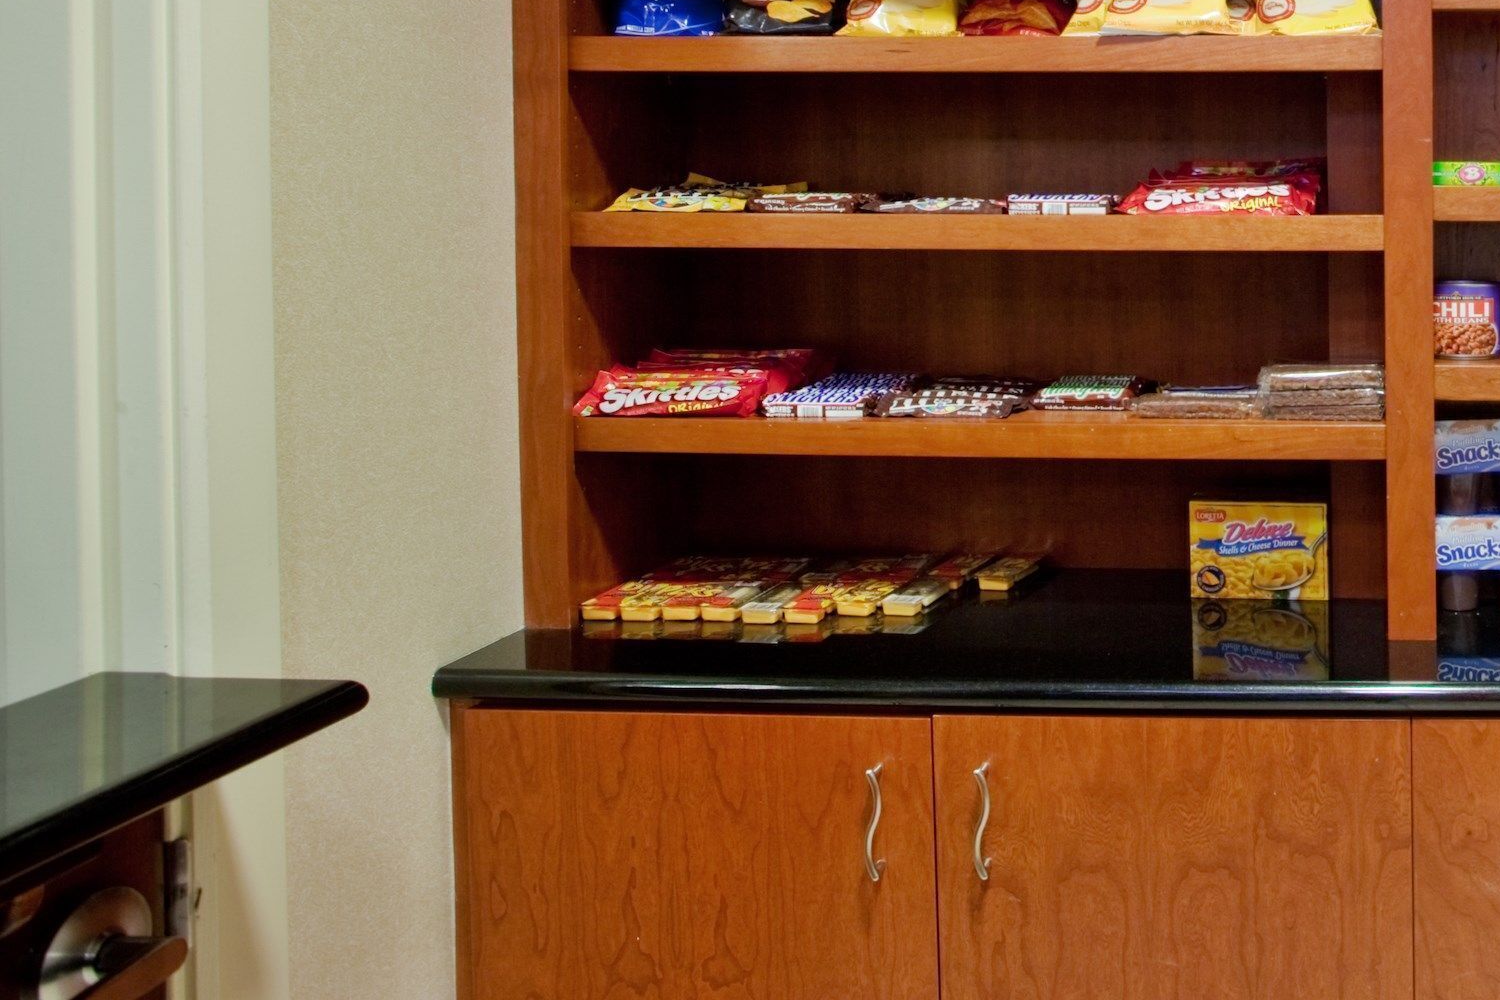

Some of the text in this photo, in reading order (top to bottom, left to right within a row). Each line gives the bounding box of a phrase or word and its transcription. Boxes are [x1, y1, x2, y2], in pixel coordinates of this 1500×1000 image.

[1144, 184, 1290, 211] Skittles
[1433, 302, 1490, 317] CHILI
[599, 386, 742, 413] Skittles
[1197, 512, 1224, 520] LORETTA
[1222, 519, 1294, 544] Deluxe
[1219, 546, 1238, 556] Shells
[1248, 542, 1272, 552] Cheese
[1272, 540, 1298, 548] Dinner
